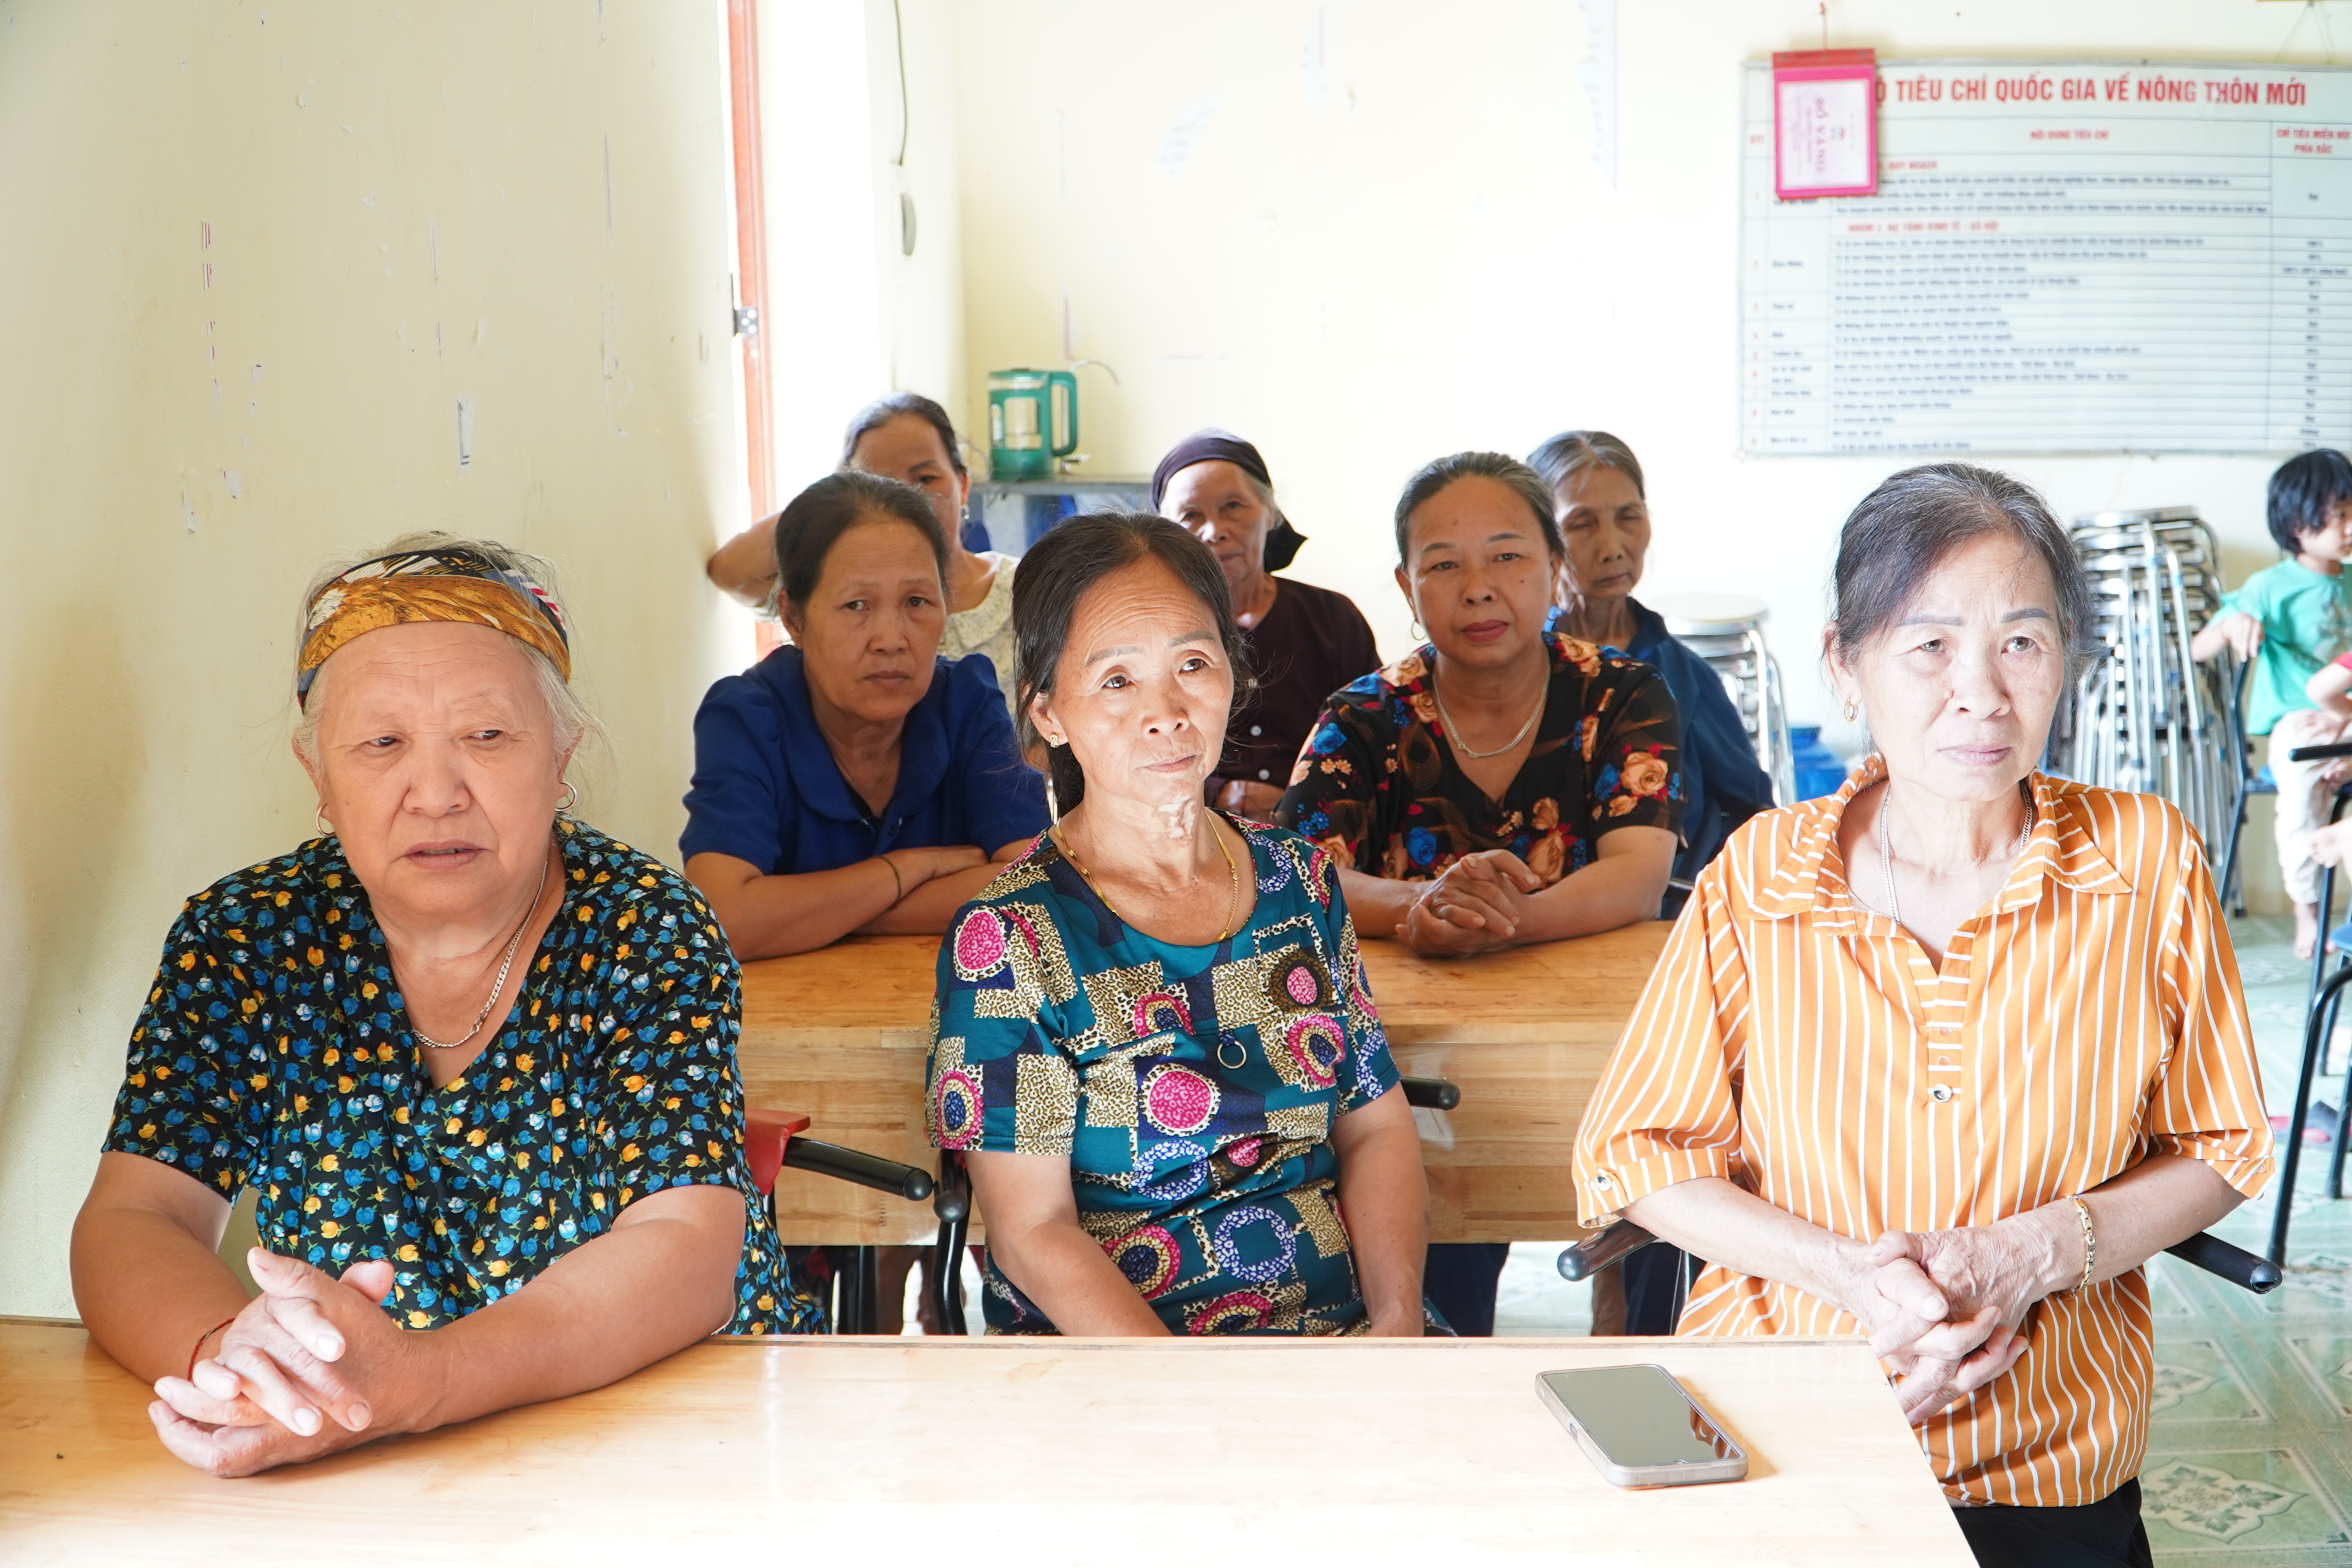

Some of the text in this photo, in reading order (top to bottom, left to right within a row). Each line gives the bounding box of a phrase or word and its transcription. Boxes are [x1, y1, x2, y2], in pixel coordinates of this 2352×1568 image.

[1876, 75, 1887, 109] Ộ
[1896, 74, 1942, 101] TIÊU
[1951, 72, 1987, 101] CHÍ
[1995, 71, 2053, 103] QUỐC
[2061, 78, 2097, 100] GIA
[2137, 74, 2197, 102] NÔNG
[2204, 77, 2259, 104] THÔN
[2266, 76, 2306, 106] MỚI
